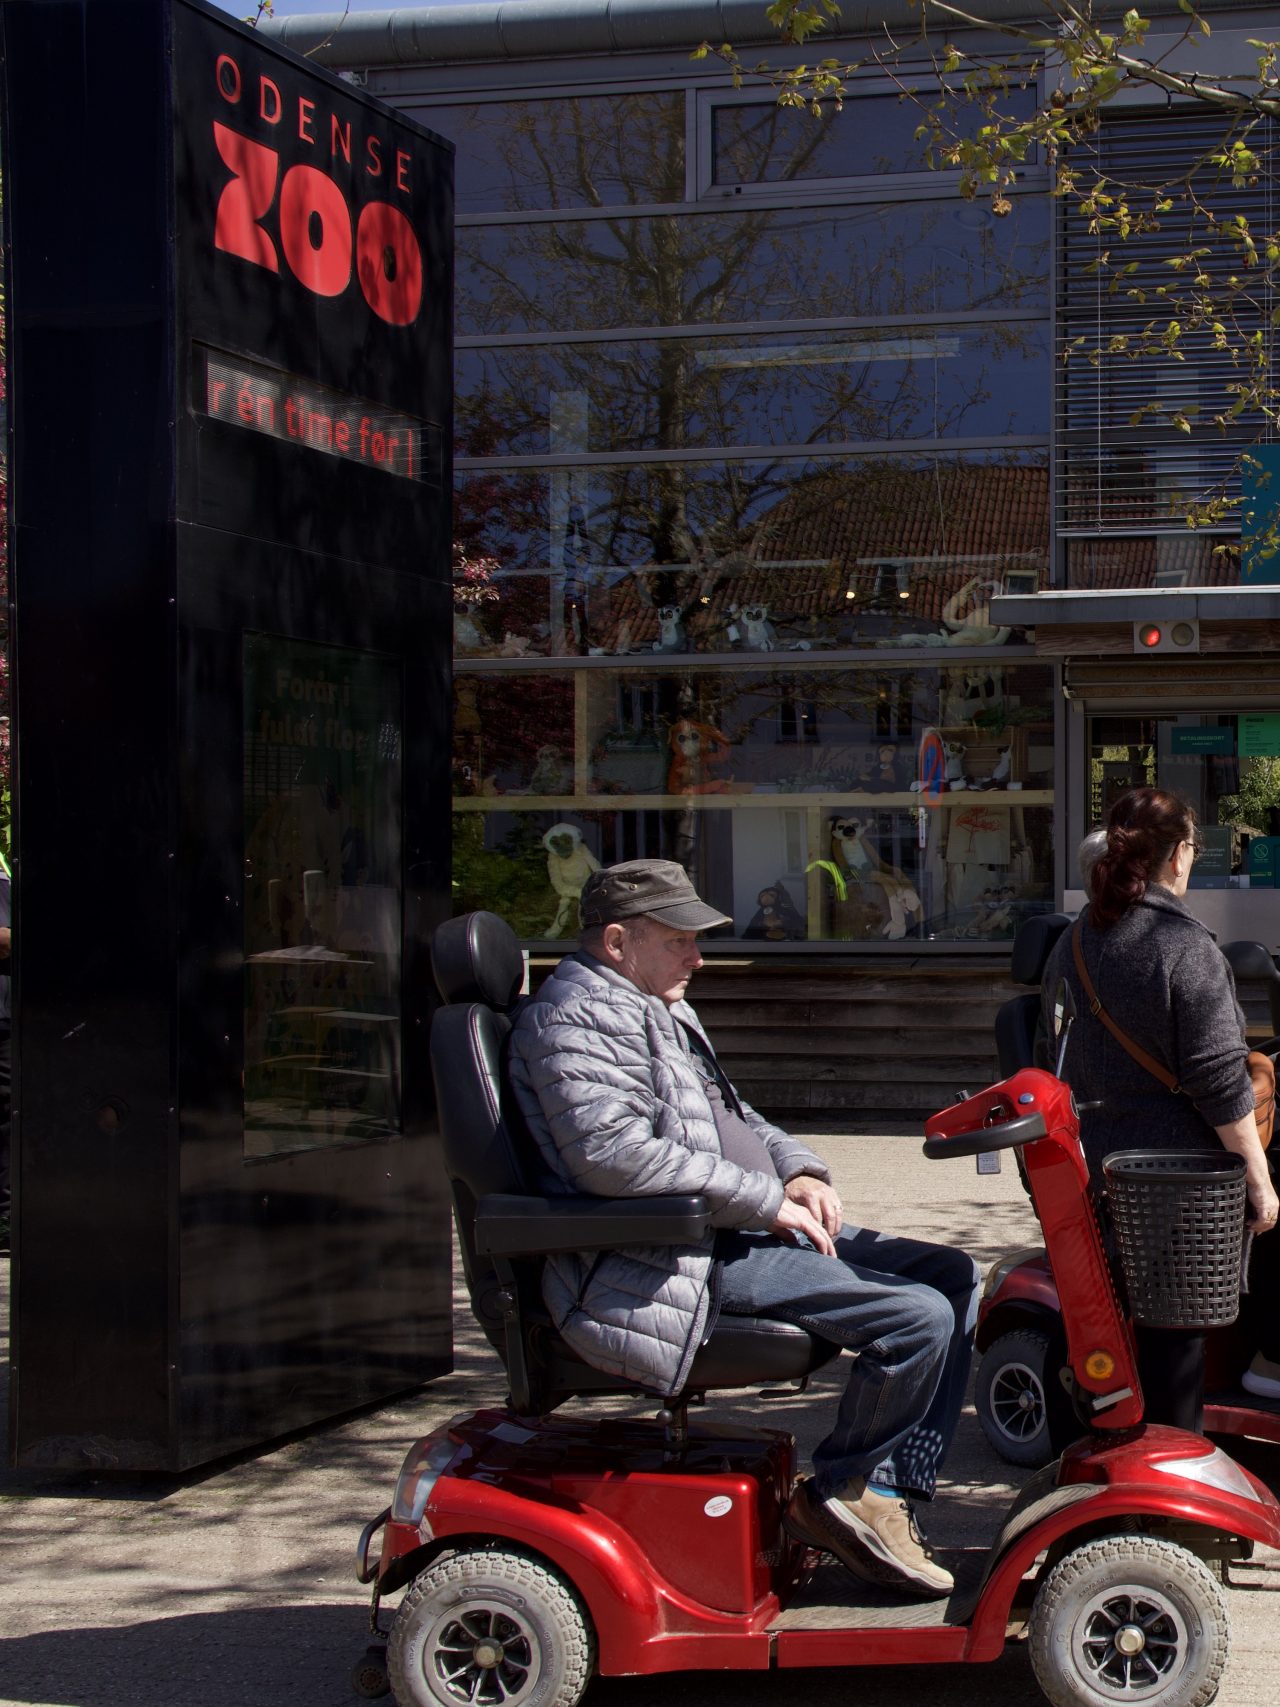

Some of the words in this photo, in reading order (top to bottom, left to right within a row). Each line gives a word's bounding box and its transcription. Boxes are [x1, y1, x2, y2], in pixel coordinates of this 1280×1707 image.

[215, 53, 412, 193] ODENSE
[212, 119, 424, 327] ZOO
[284, 396, 351, 454] time
